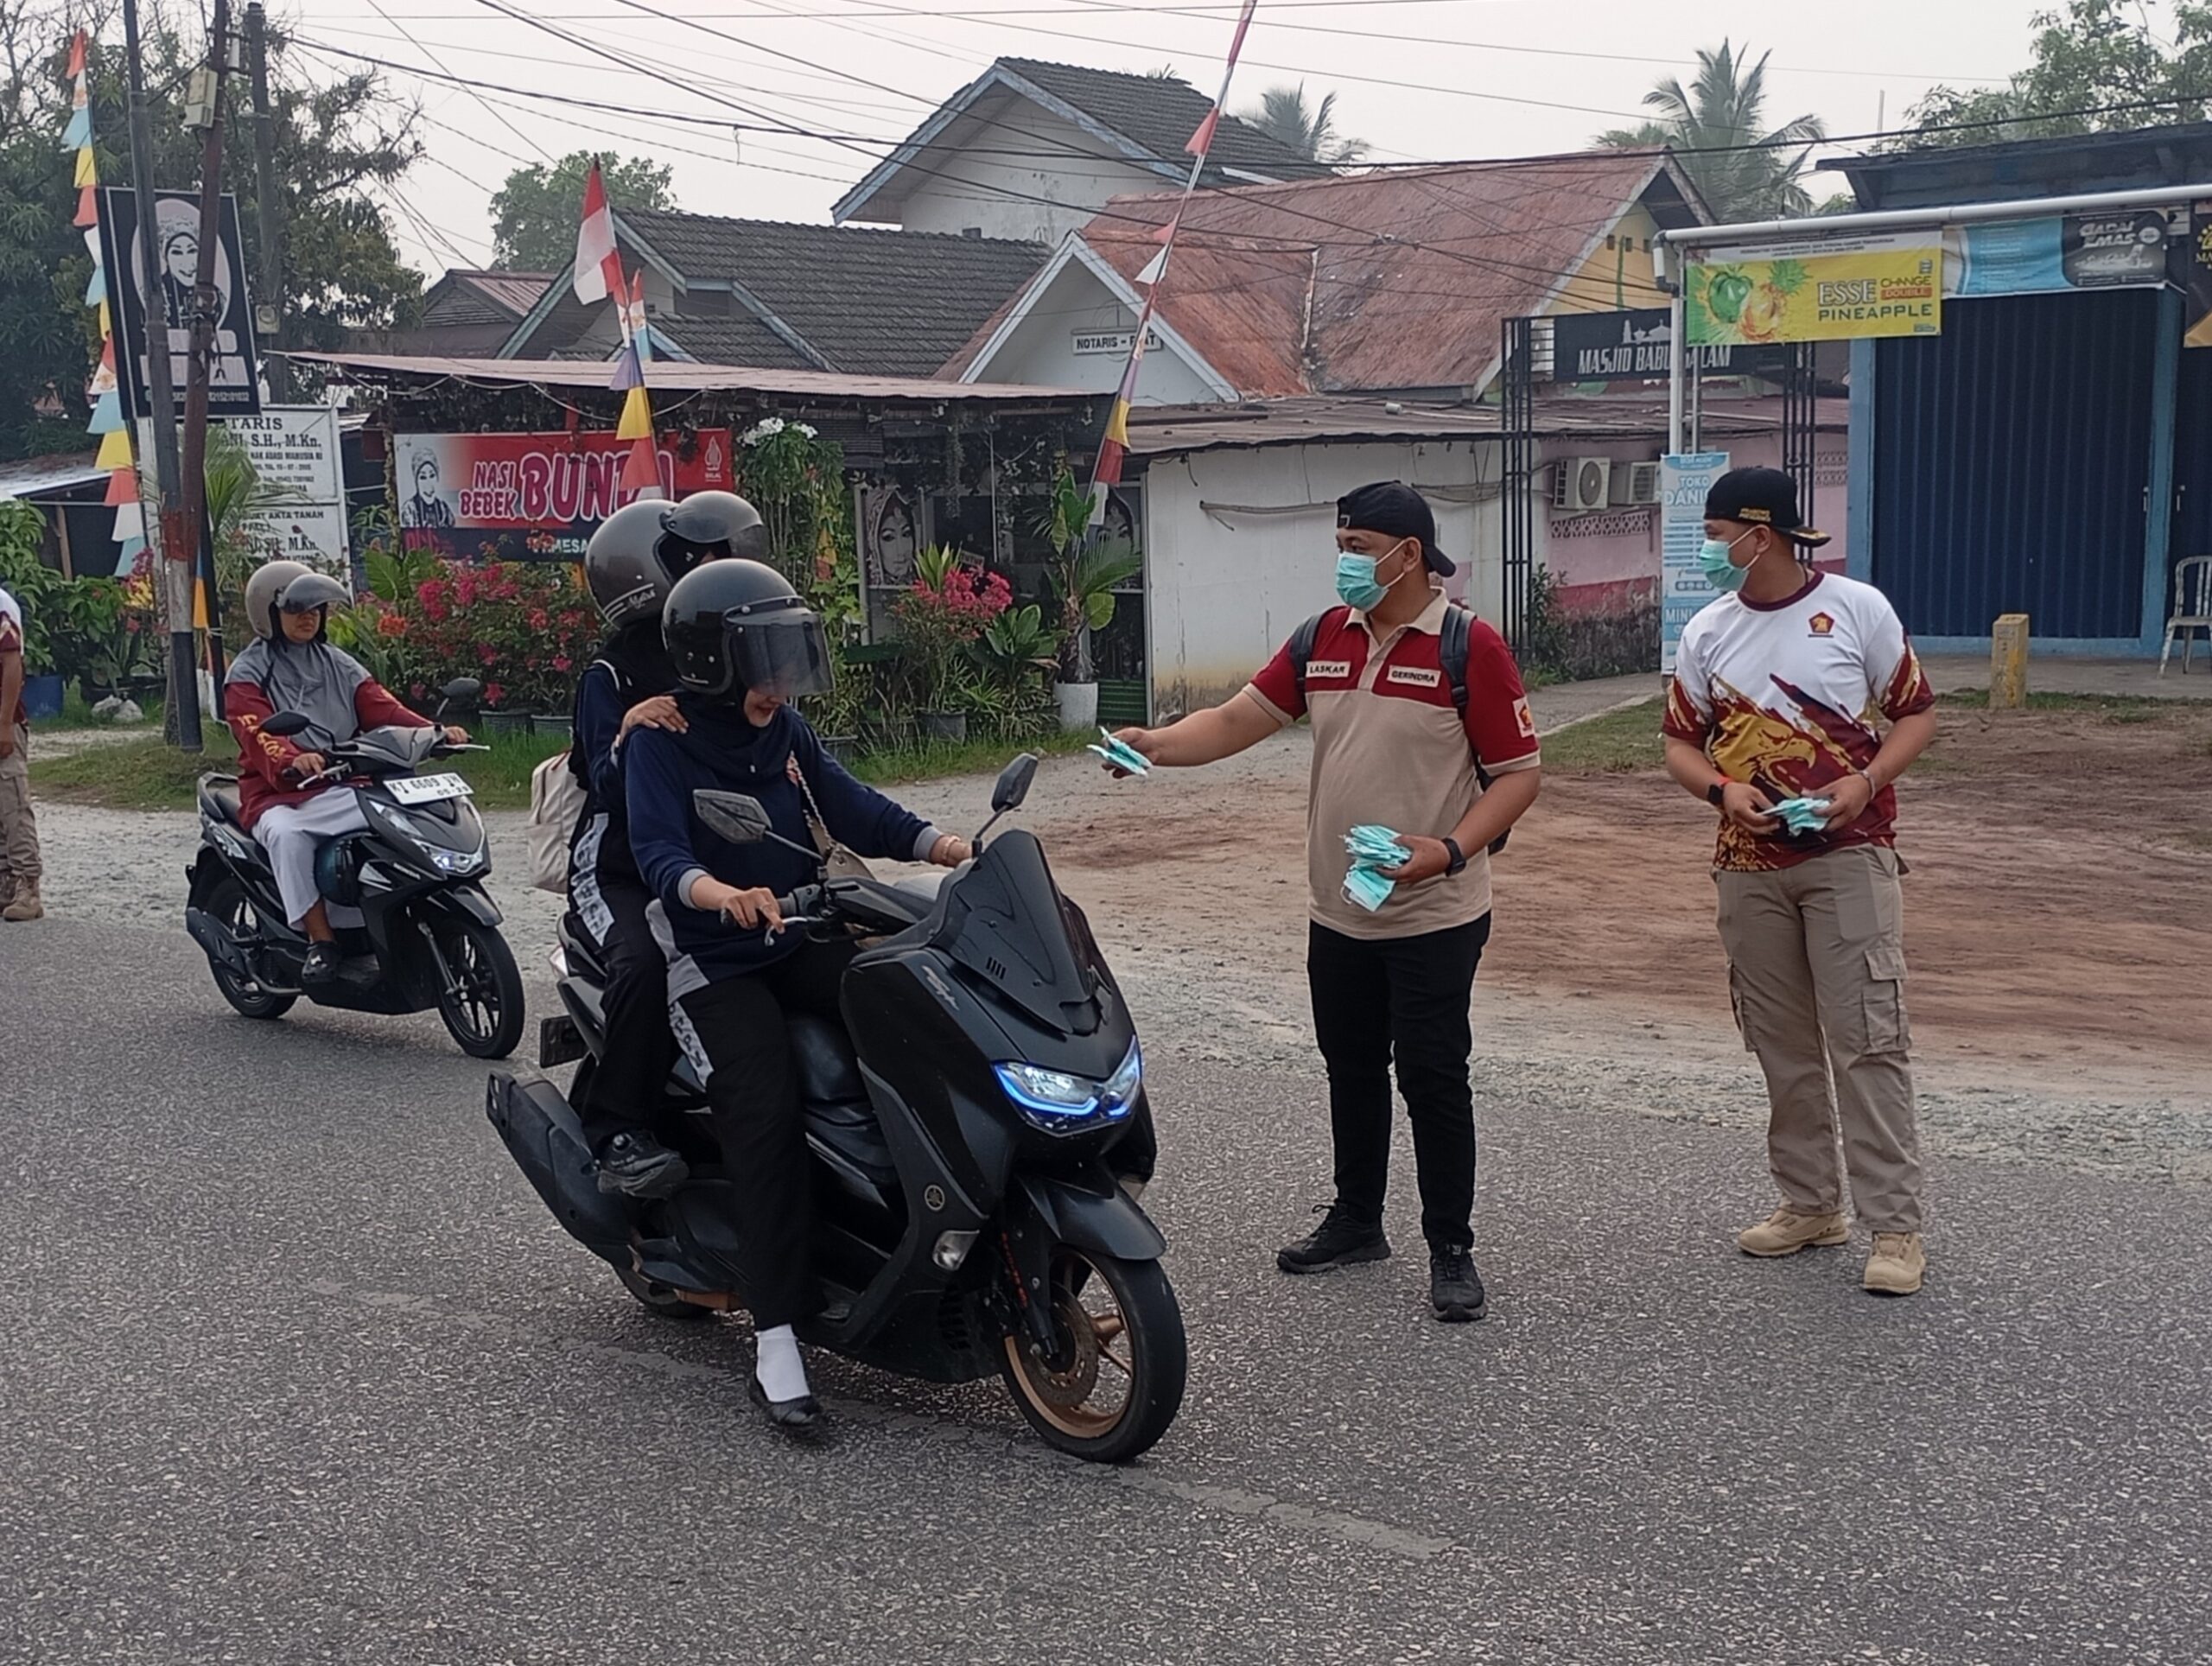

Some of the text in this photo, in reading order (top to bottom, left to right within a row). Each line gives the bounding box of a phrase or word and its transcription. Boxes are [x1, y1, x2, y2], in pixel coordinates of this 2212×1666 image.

[1817, 276, 1932, 307] ESSE CHANGE
[1818, 304, 1933, 321] PINEAPPLE
[1077, 336, 1118, 350] NOTARIS
[1578, 347, 1632, 374] MASJID
[473, 461, 518, 491] NASI
[1679, 476, 1710, 488] TOKO
[459, 489, 518, 521] BEBEK
[1663, 489, 1708, 506] DANI
[1309, 665, 1436, 684] LASKAR GERINDRA
